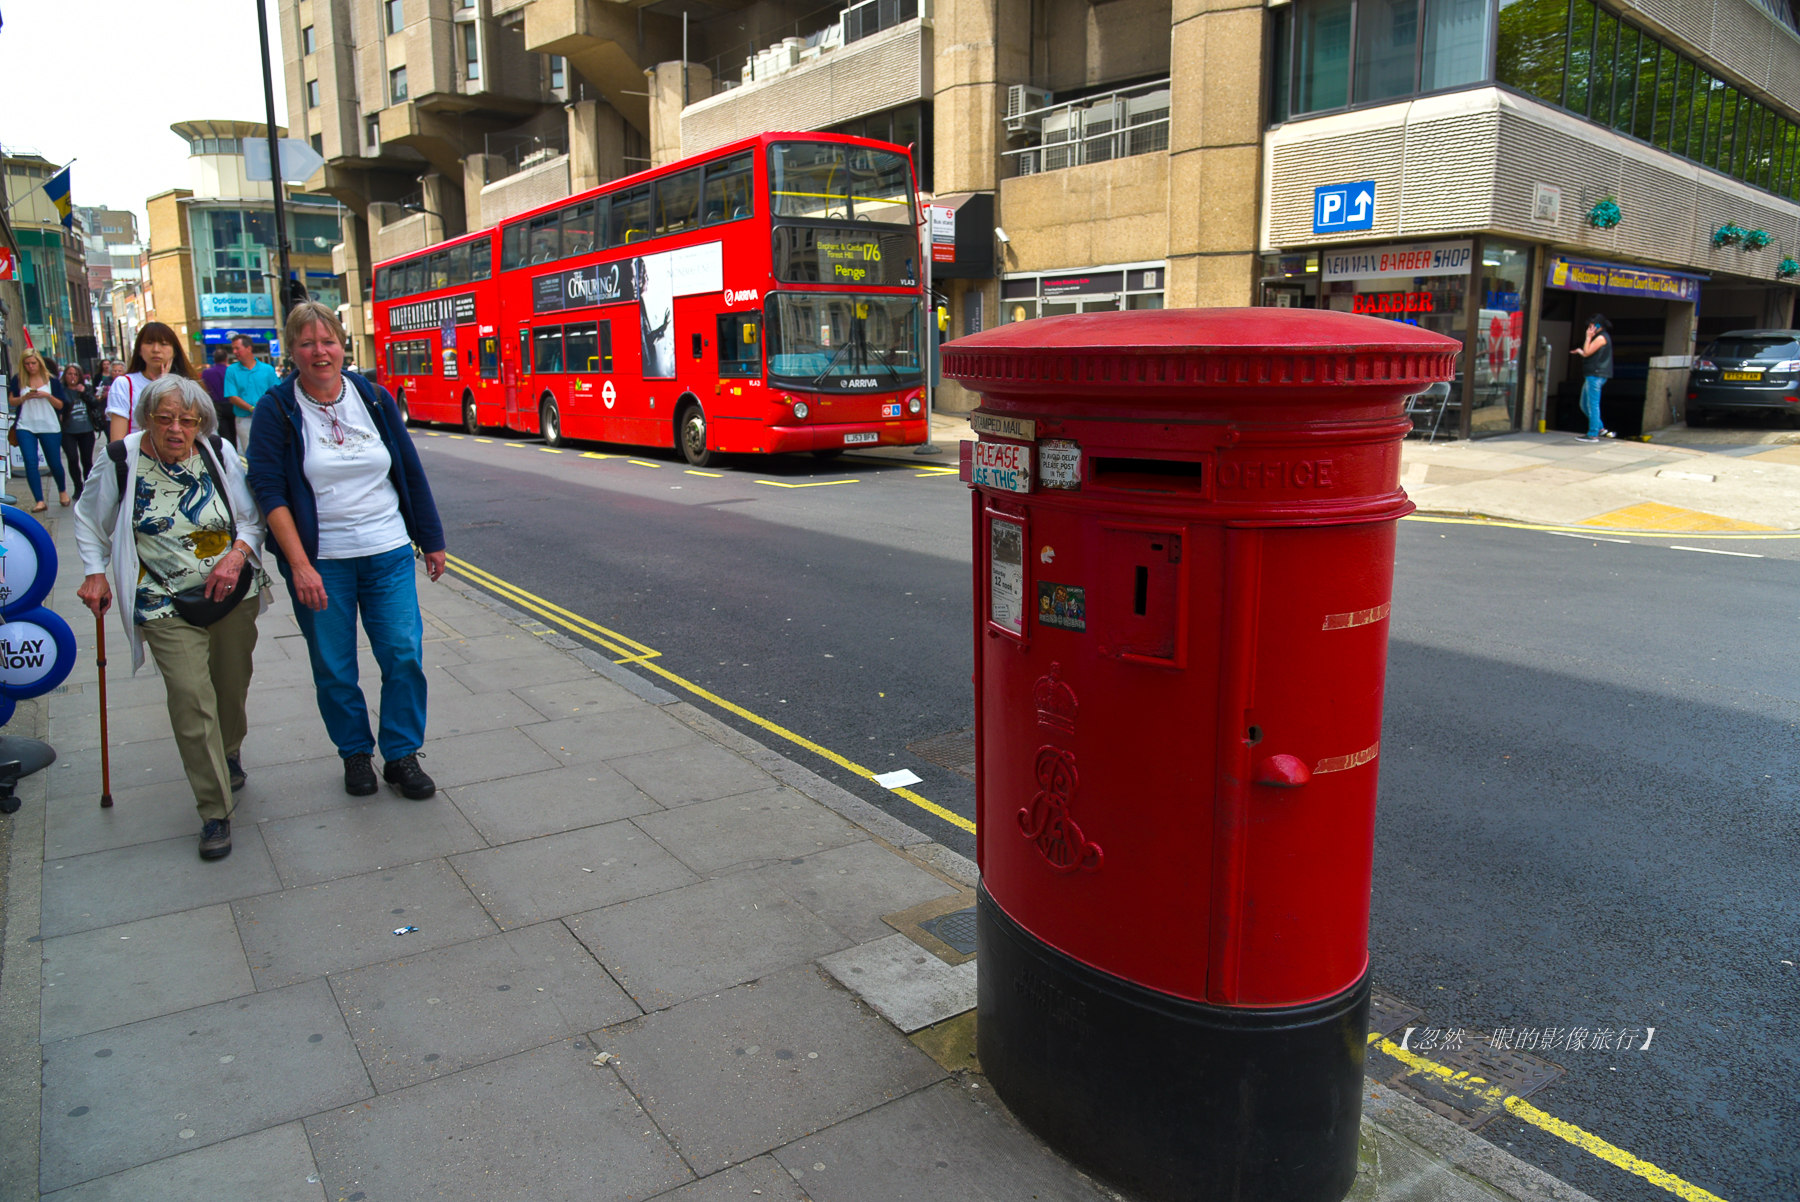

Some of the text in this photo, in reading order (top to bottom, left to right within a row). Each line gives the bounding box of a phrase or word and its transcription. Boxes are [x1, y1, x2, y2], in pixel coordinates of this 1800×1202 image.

[1322, 194, 1341, 224] P
[827, 250, 854, 259] Forest Hill
[863, 243, 881, 262] 176
[1379, 250, 1432, 272] BARBER
[1432, 248, 1471, 268] SHOP
[835, 264, 866, 281] Penge
[1571, 267, 1599, 285] Welcome
[1600, 273, 1607, 286] to
[1607, 272, 1633, 288] Tottenham
[1634, 276, 1648, 290] Court
[1648, 277, 1660, 291] Road
[1660, 279, 1669, 292] Car
[1669, 280, 1679, 293] Park
[568, 276, 612, 304] CONJURING
[611, 264, 621, 298] 2
[212, 296, 248, 305] Opticians
[734, 289, 758, 302] ARRIVA
[1351, 292, 1434, 314] BARBER
[213, 305, 248, 313] first floor
[848, 378, 878, 388] ARRIVA
[974, 414, 1023, 436] STAMPED MAIL
[976, 443, 1020, 470] PLEASE
[1040, 452, 1078, 462] TO AVOID DELAY
[1043, 461, 1075, 471] PLEASE POST
[1056, 470, 1066, 478] THE
[1218, 459, 1333, 489] OFFICE
[973, 467, 990, 486] USE
[993, 567, 1006, 578] Saturday
[994, 575, 1001, 587] 12
